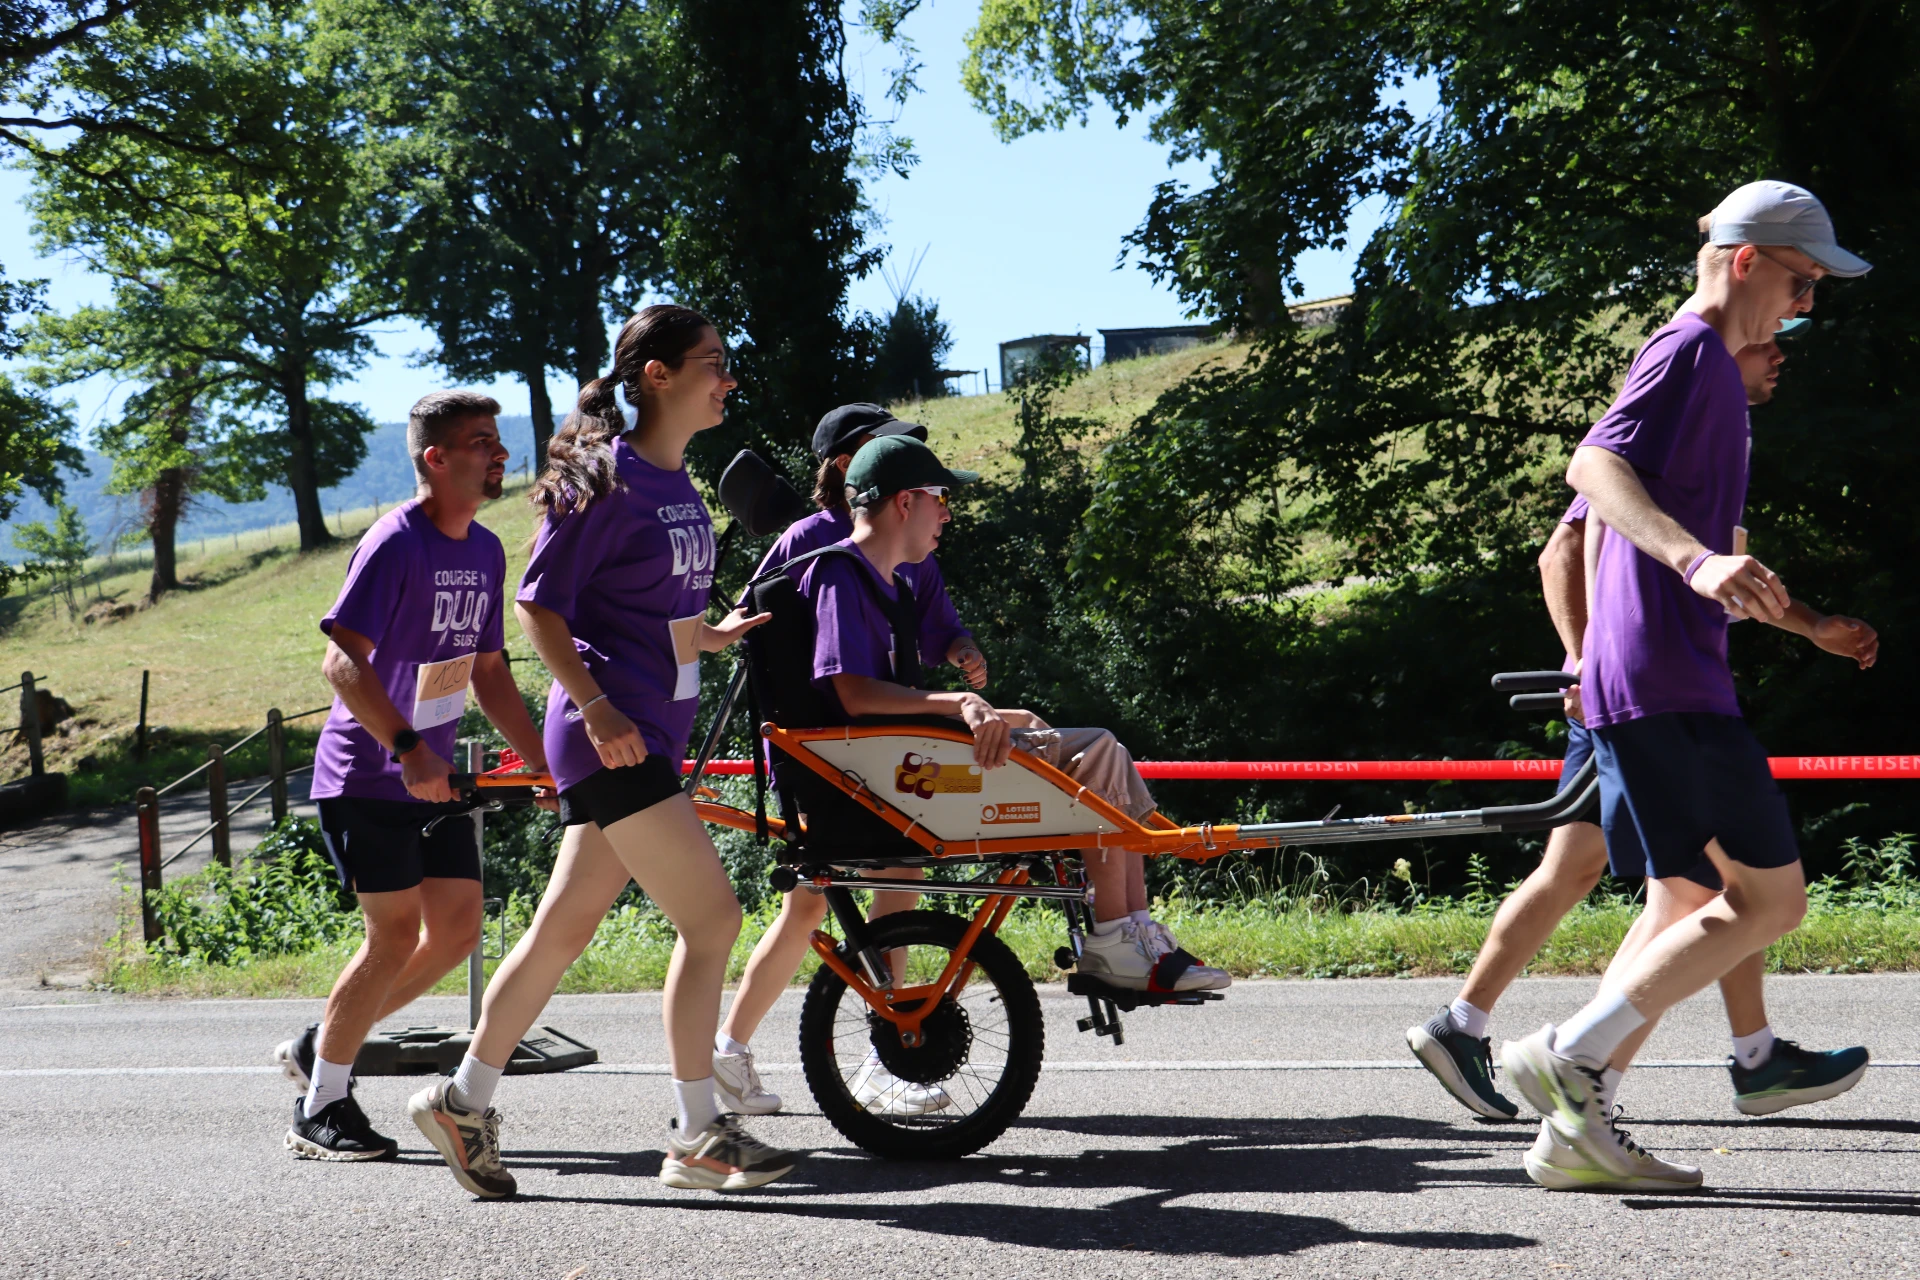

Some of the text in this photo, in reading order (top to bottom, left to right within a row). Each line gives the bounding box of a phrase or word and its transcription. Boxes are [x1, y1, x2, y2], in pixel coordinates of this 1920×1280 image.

[657, 503, 701, 523] COURSE
[435, 570, 478, 586] COURSE
[431, 590, 489, 633] DUO
[434, 661, 468, 692] 120
[1247, 762, 1359, 772] RAIFFEISEN
[1006, 805, 1039, 813] LOTERIE
